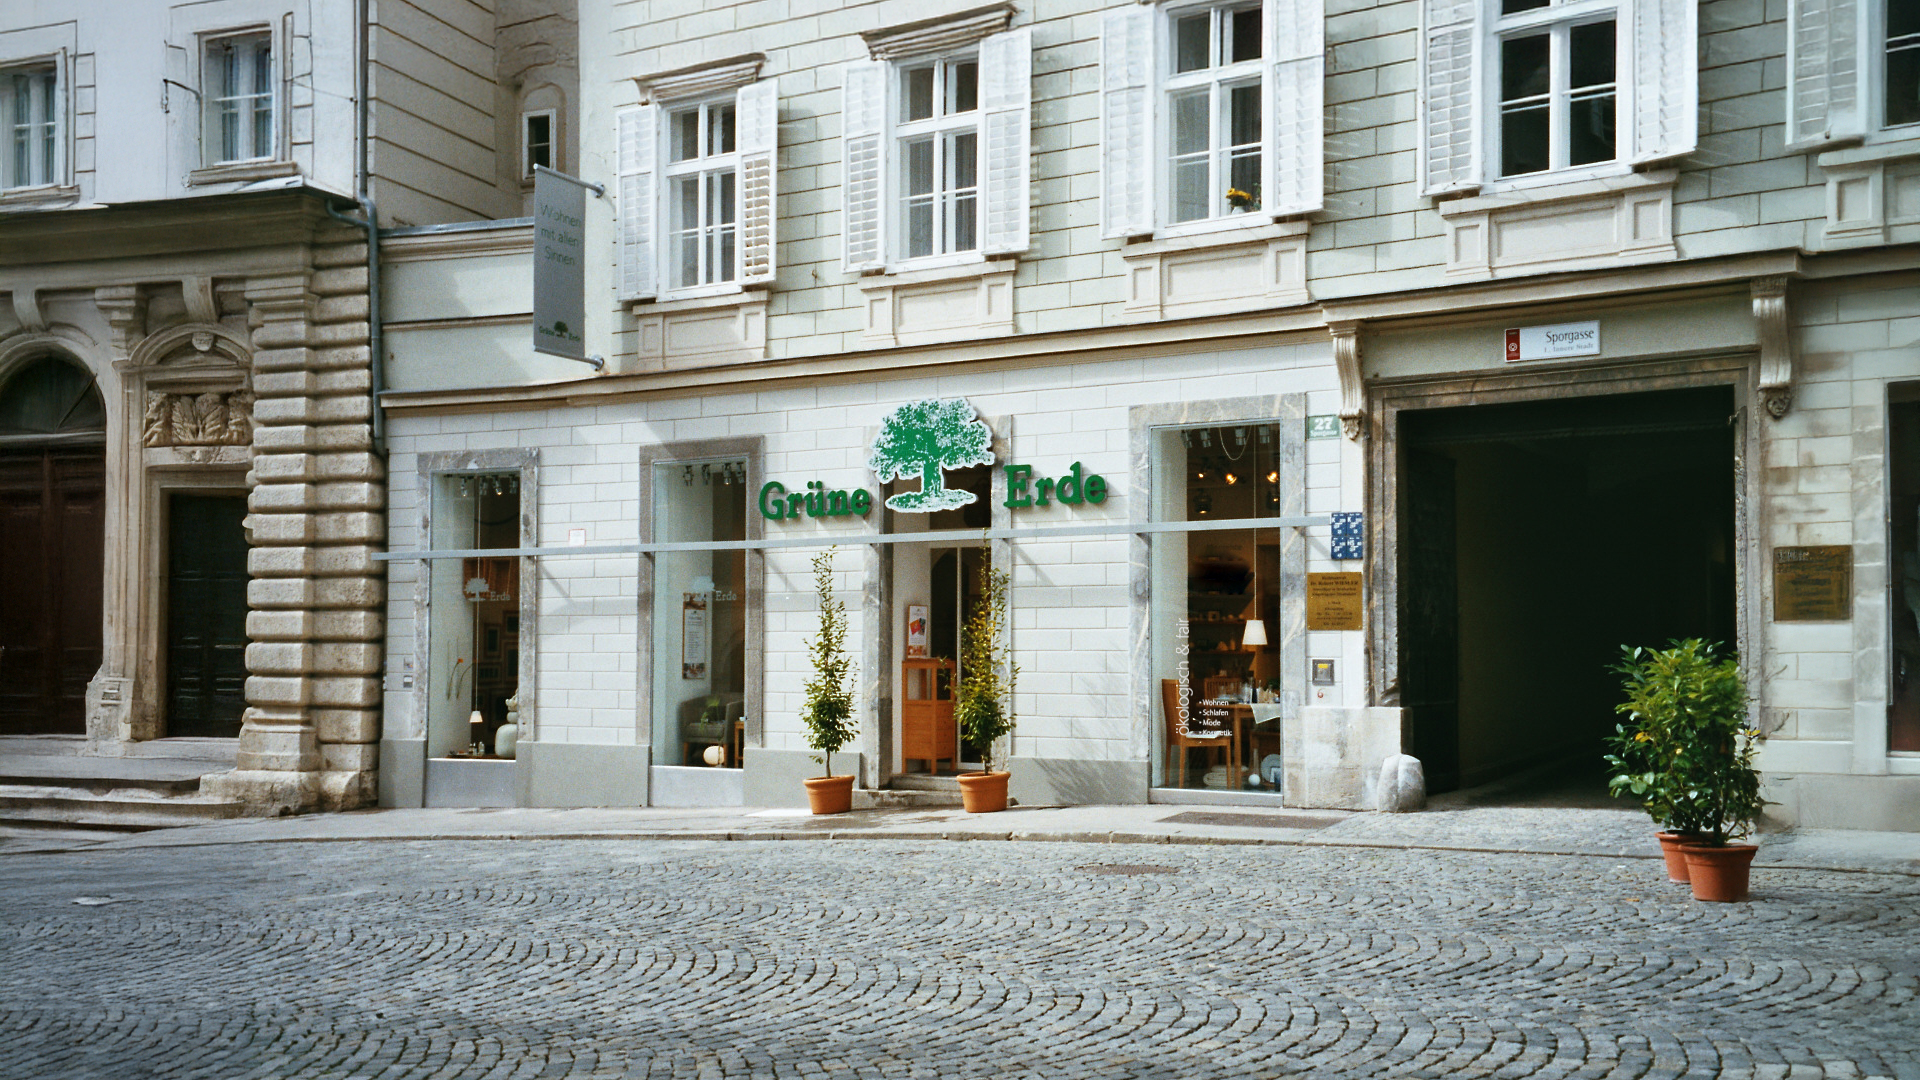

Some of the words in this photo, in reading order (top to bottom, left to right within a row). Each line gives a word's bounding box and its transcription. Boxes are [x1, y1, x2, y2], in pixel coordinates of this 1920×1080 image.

[540, 204, 582, 228] Wohnen
[541, 228, 556, 241] mit
[558, 231, 579, 247] allen
[545, 246, 576, 266] Sinnen
[1546, 329, 1595, 346] Sporgasse
[1314, 417, 1334, 431] 27
[758, 480, 873, 520] Grüne
[1003, 460, 1108, 509] Erde
[489, 591, 511, 602] Erde
[715, 590, 737, 601] Erde
[1175, 618, 1190, 639] fair
[1175, 643, 1190, 655] &
